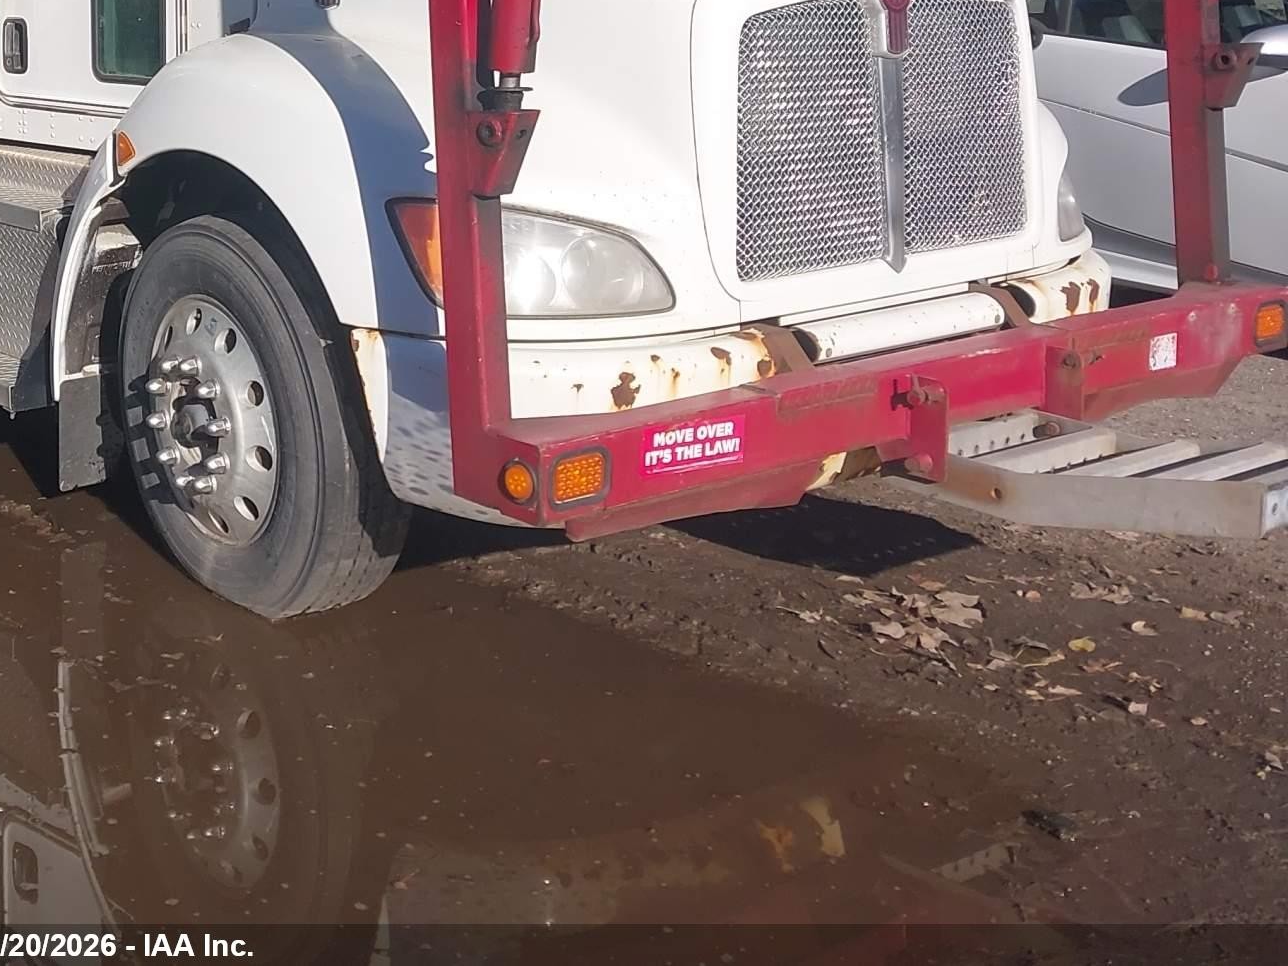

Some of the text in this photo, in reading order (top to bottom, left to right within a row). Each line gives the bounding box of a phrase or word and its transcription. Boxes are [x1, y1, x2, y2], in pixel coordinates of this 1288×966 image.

[653, 422, 734, 447] MOVE OVER
[645, 438, 740, 466] IT'S THE LAW!
